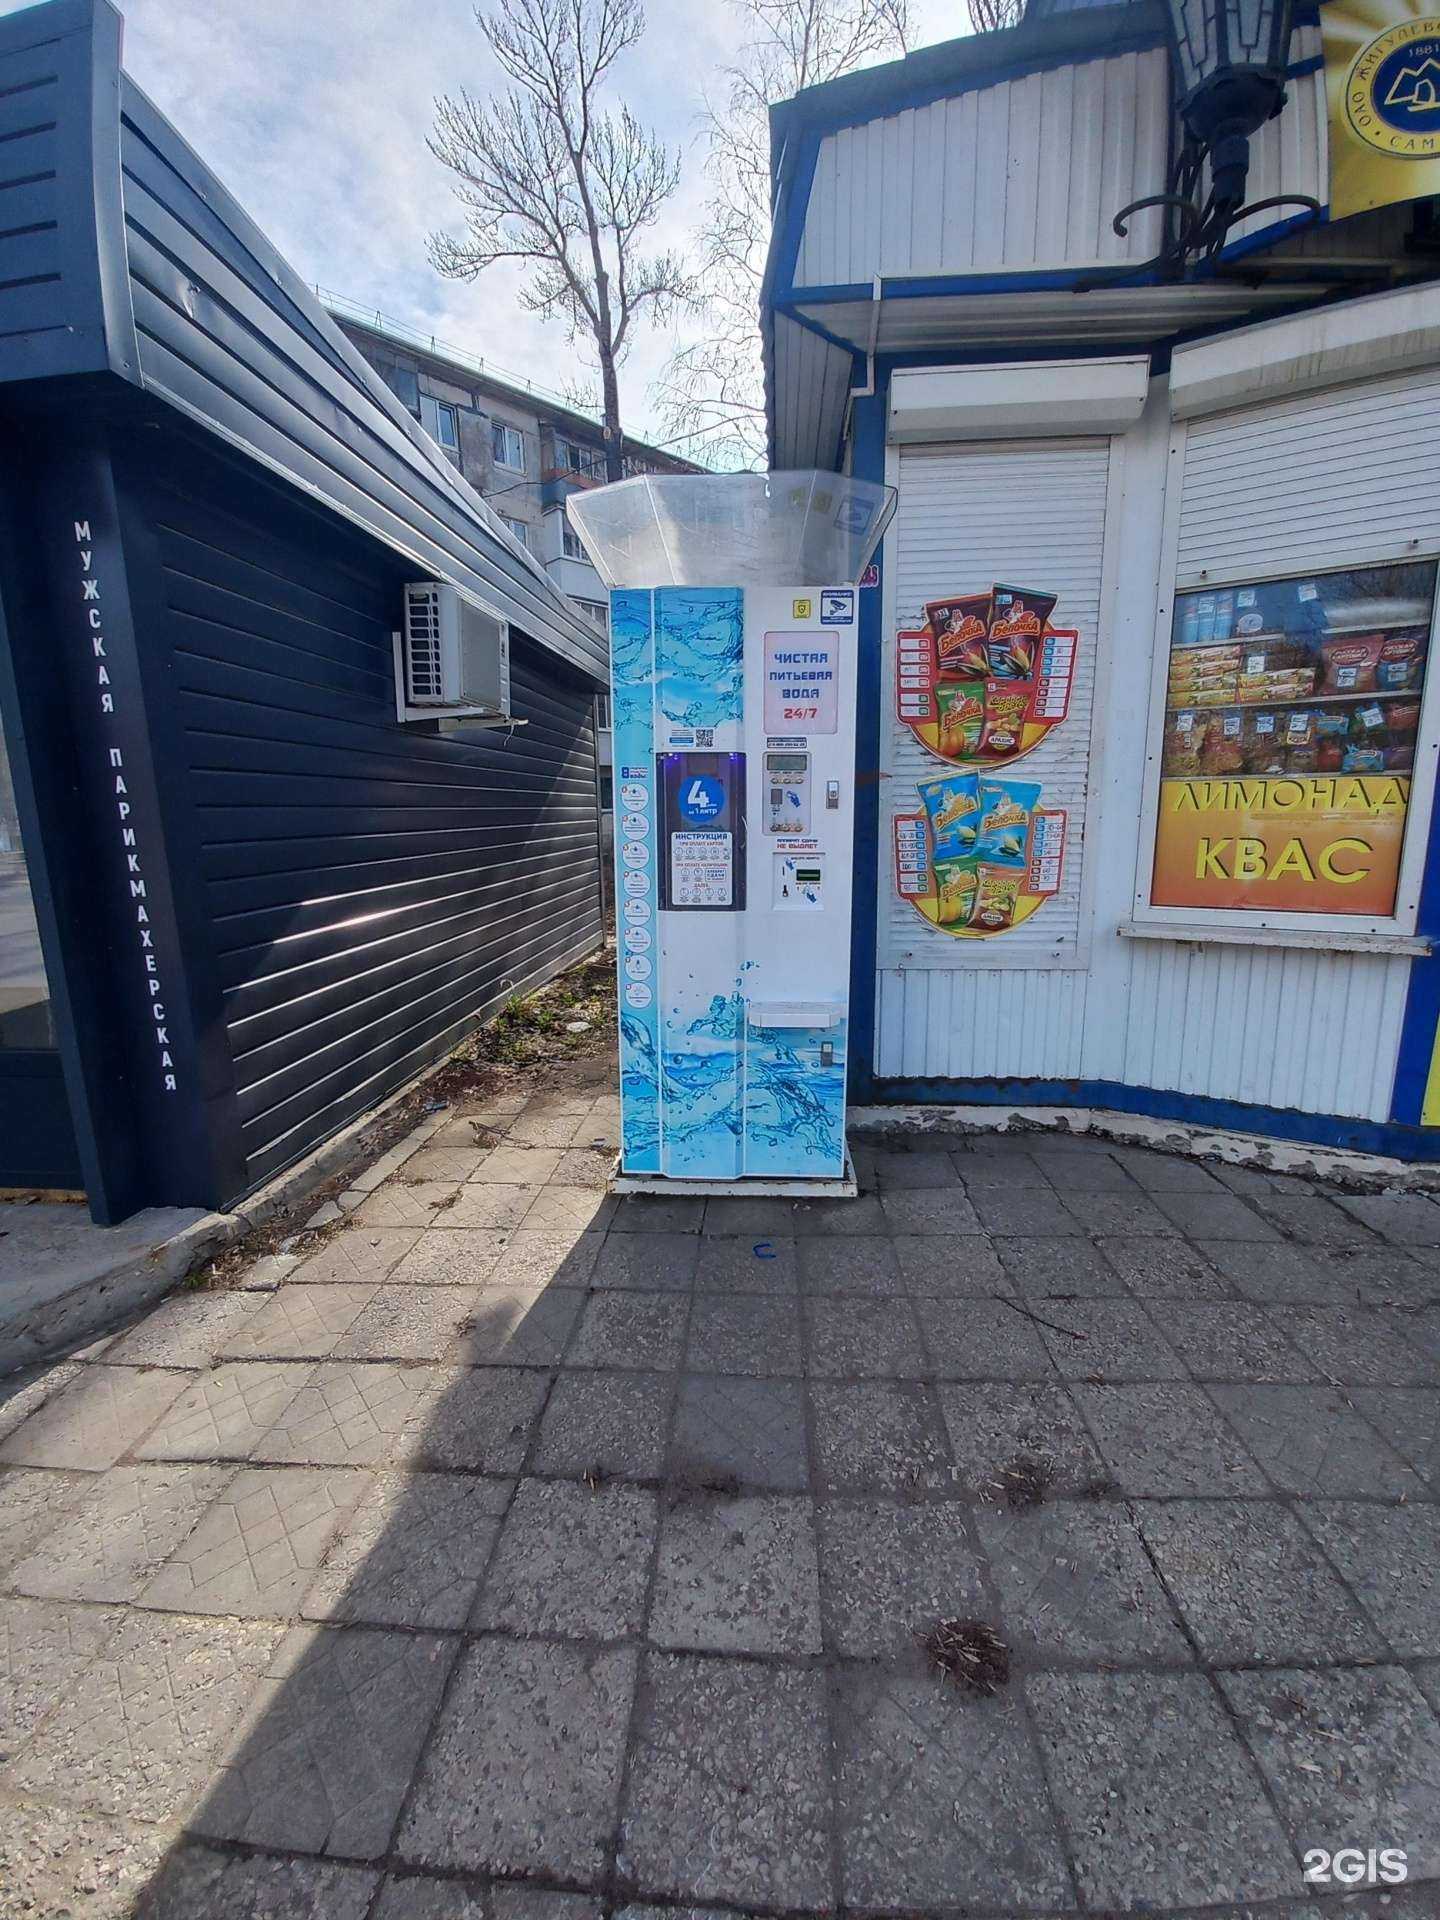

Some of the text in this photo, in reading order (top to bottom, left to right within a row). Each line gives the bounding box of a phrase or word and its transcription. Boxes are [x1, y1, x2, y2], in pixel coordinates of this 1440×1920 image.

[1352, 91, 1372, 127] ОАО
[774, 653, 828, 663] ЧИСТАЯ
[769, 671, 833, 681] ПИТЬЕВАЯ
[782, 688, 820, 698] ВОДА
[784, 707, 818, 719] 24/7
[687, 780, 710, 808] 4
[1174, 778, 1408, 815] ЛИМОНАД
[74, 520, 177, 1091] МУЖСКАЯ ПАРИКМАХЕРСКАЯ
[675, 833, 728, 841] ИНСТРУКЦИЯ
[1195, 837, 1374, 884] КВАС
